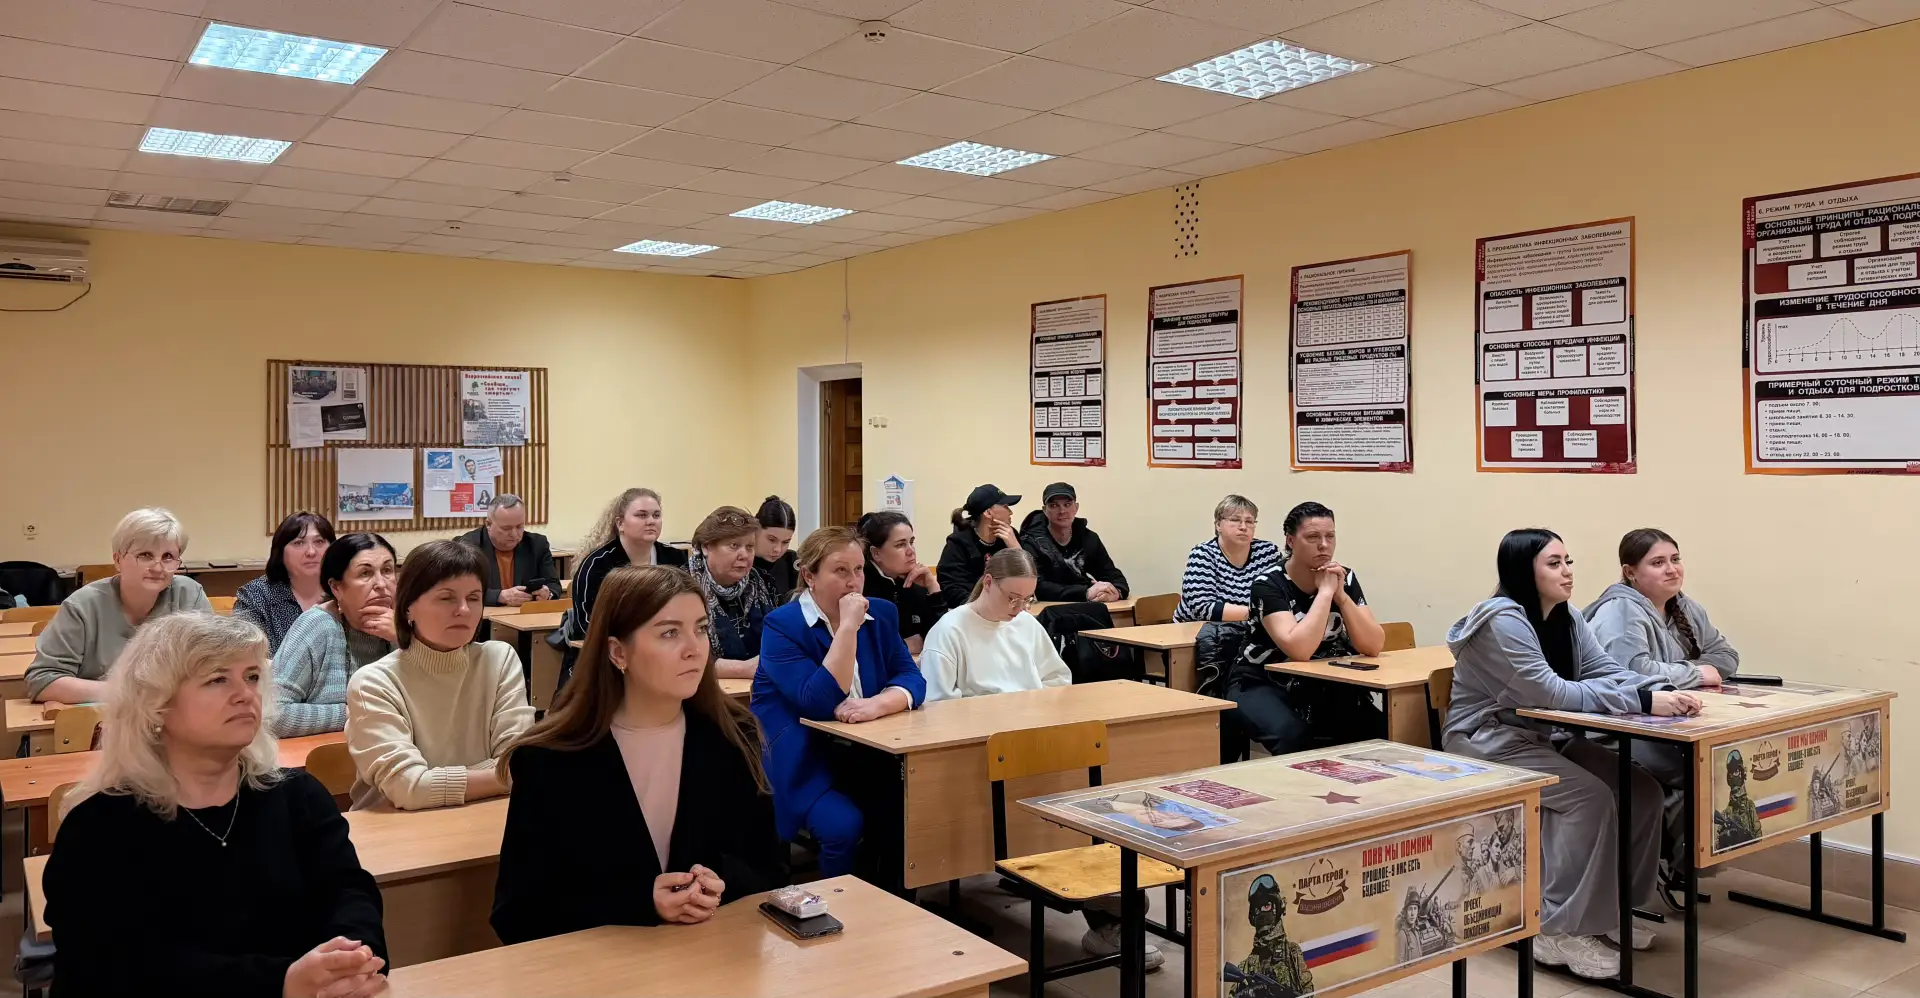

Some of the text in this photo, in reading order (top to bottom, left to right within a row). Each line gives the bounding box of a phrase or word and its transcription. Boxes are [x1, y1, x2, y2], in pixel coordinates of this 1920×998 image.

[1765, 205, 1790, 213] РЕЖИМ
[1828, 195, 1859, 204] ОТДЫХА
[1756, 225, 1813, 238] ОРГАНИЗАЦИИ
[1816, 221, 1841, 230] ТРУДА
[1854, 216, 1890, 225] ОТДЫХА
[1765, 217, 1812, 229] ОСНОВНЫЕ
[1816, 211, 1864, 223] ПРИНЦИПЫ
[1492, 243, 1532, 252] ПРОФИЛАКТИКА
[1534, 237, 1578, 246] ИНФЕКЦИОННЫХ
[1581, 229, 1622, 240] ЗАБОЛЕВАНИЙ
[1490, 278, 1619, 297] ОПАСНОСТЬ ИНФЕКЦИОННЫХ ЗАБОЛЕВАНИЙ
[1780, 296, 1829, 306] ИЗМЕНЕНИЕ
[1827, 301, 1865, 310] ТЕЧЕНИЕ
[1869, 298, 1888, 308] ДНЯ
[1587, 335, 1621, 343] ИНФЕКЦИИ
[1768, 380, 1820, 389] ПРИМЕРНЫЙ
[1824, 377, 1872, 387] СУТОЧНЫЙ
[1798, 387, 1833, 395] ОТДЫХА
[1860, 384, 1919, 393] ПОДРОСТКОВ
[1362, 834, 1432, 868] ПОКА МЫ ПОМНИМ
[1408, 858, 1420, 872] ЕСТЬ
[1298, 868, 1344, 890] ПАРТА ГЕРОЯ
[1362, 879, 1390, 898] БУДУЩЕЕ!
[1464, 897, 1482, 912] ПРОЕКТ,
[1464, 902, 1502, 926] ОБЪЕДИНЯЮЩИЙ
